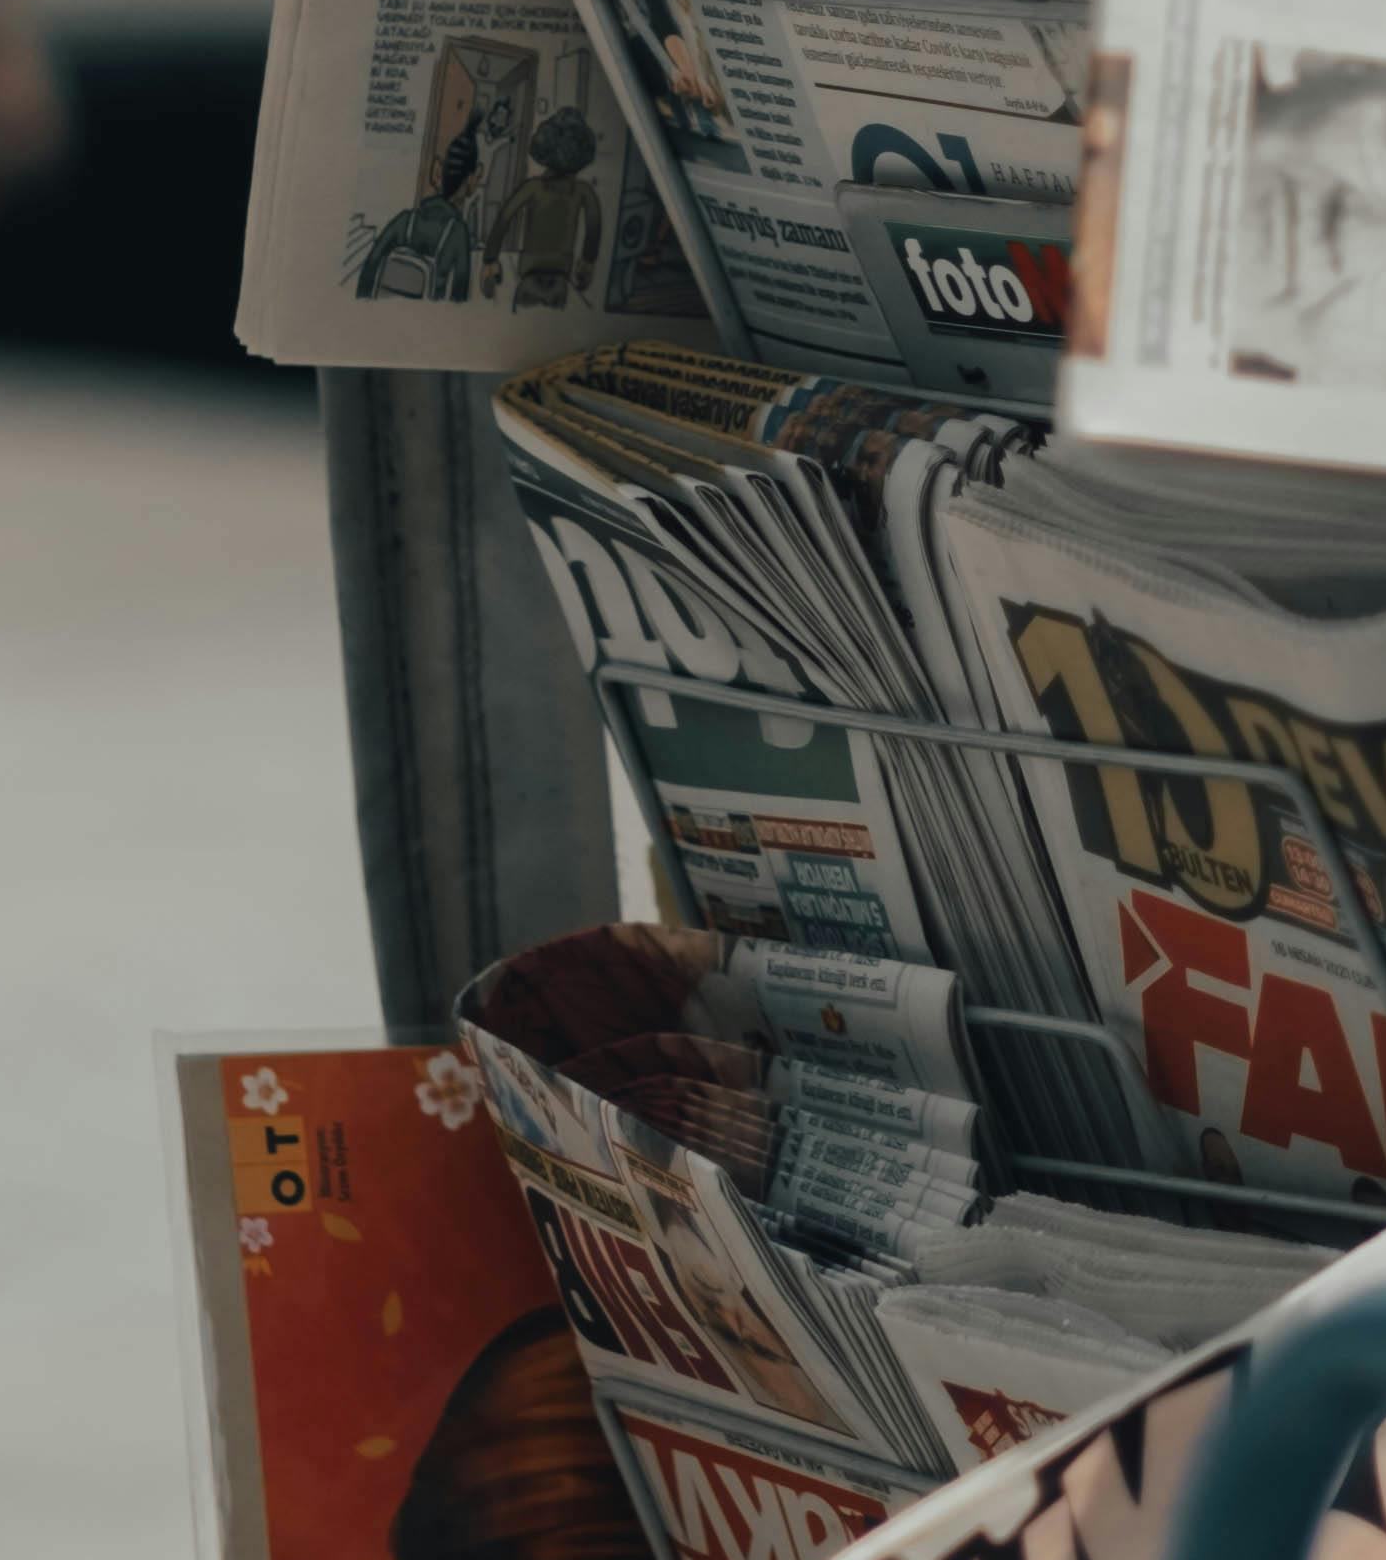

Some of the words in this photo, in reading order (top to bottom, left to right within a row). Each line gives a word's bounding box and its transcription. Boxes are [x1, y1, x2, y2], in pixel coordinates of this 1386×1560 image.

[991, 160, 1081, 196] HAFTAL
[700, 195, 780, 247] Yürüyüş
[783, 219, 849, 253] zamanı
[903, 237, 1071, 326] fotoM
[672, 385, 755, 431] yaşanıyor
[1161, 839, 1251, 896] BÜLTEN
[265, 1125, 306, 1207] OT
